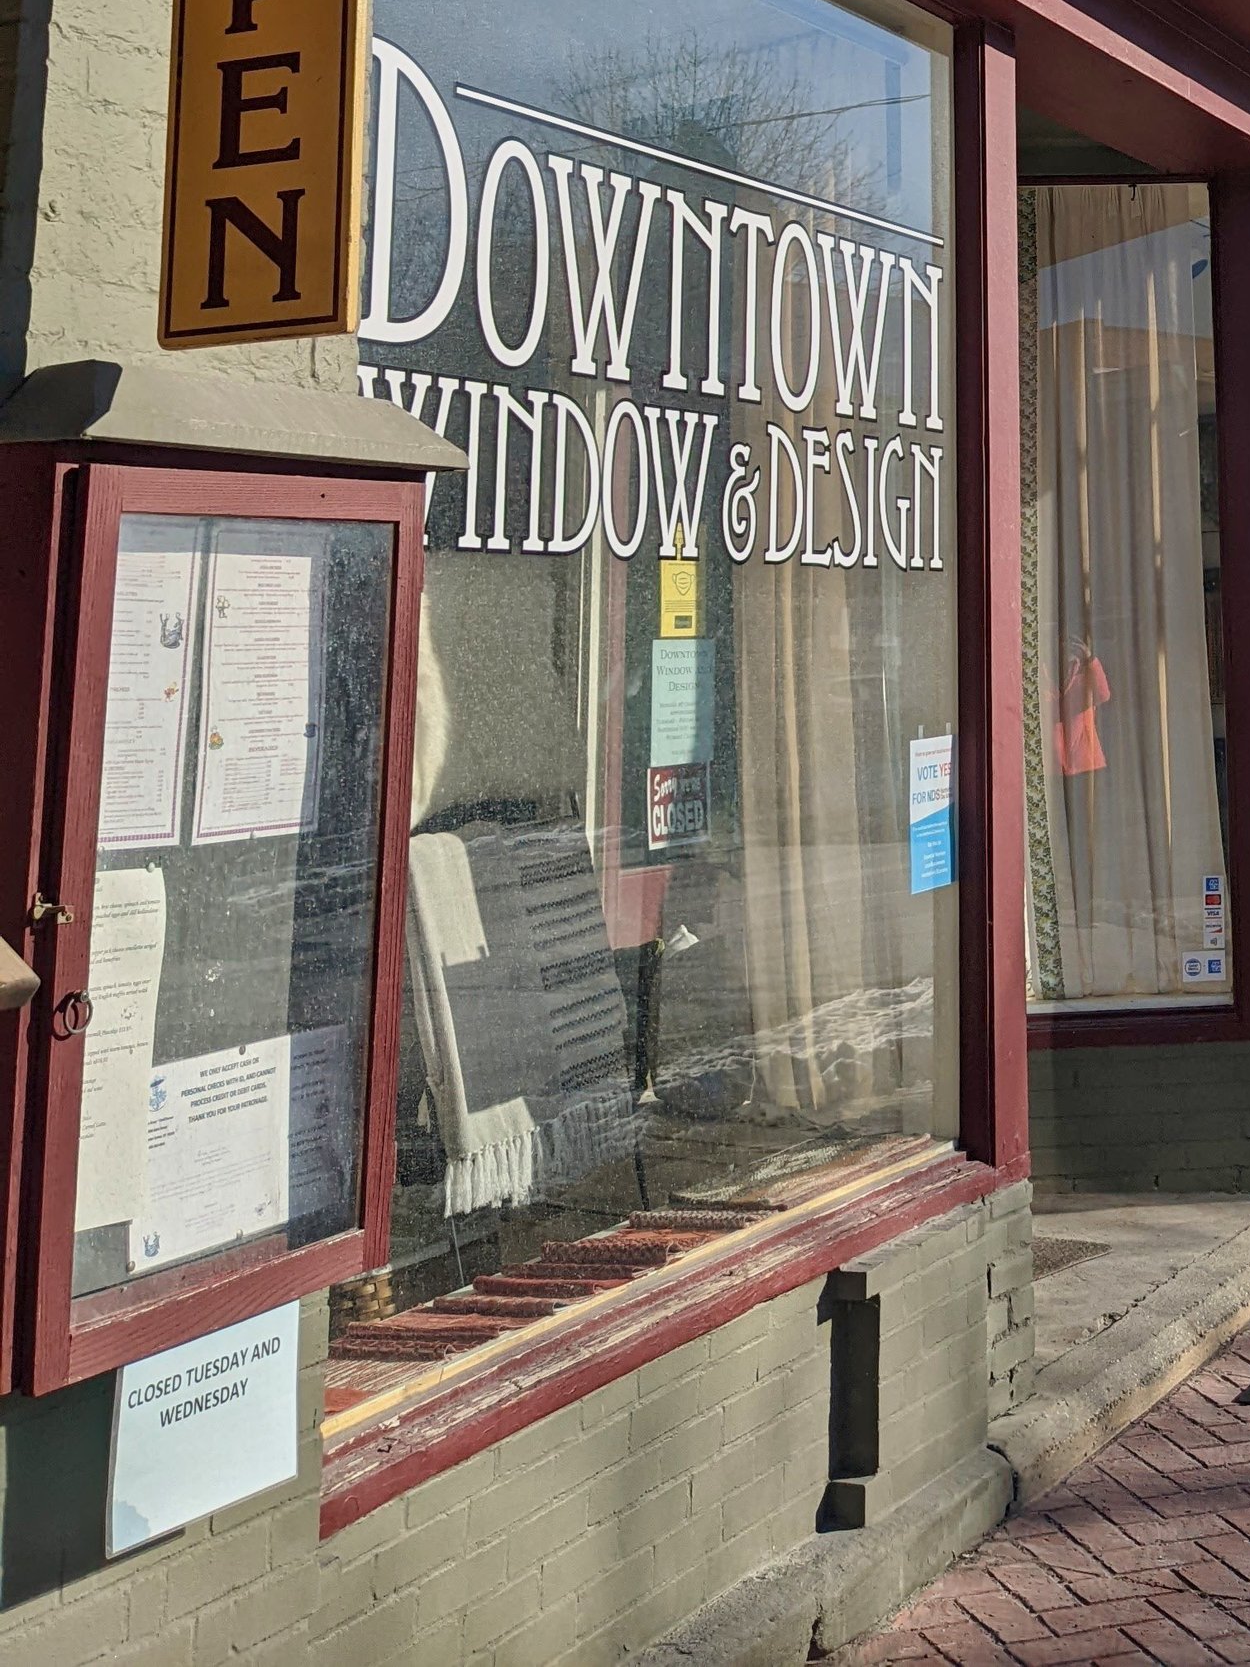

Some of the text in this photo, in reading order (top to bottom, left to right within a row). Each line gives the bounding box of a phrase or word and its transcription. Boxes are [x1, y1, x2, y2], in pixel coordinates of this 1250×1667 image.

[358, 34, 944, 432] DOWNTOWN
[722, 443, 759, 564] &
[765, 422, 944, 570] DESIGN
[656, 665, 692, 676] WINDOW
[917, 762, 953, 782] VOTE YES
[653, 773, 678, 802] Sorry
[912, 791, 927, 805] FOR
[927, 789, 940, 803] NDS
[653, 799, 704, 837] CLOSED
[181, 1086, 207, 1098] PERSONAL
[207, 1080, 225, 1091] CHECKS
[226, 1077, 239, 1086] WITH
[256, 1066, 277, 1078] CANNOT
[200, 1070, 208, 1078] WE
[209, 1067, 221, 1077] ONLY
[221, 1062, 239, 1073] ACCEPT
[240, 1059, 251, 1068] CASH
[190, 1097, 212, 1108] PROCESS
[212, 1092, 229, 1103] CREDIT
[230, 1090, 237, 1098] OR
[237, 1086, 250, 1096] DEBIT
[188, 1113, 206, 1124] THANK
[206, 1110, 216, 1120] YOU
[217, 1106, 227, 1116] FOR
[228, 1103, 240, 1113] YOUR
[127, 1336, 281, 1410] CLOSED TUESDAY AND
[160, 1377, 249, 1428] WEDNESDAY
